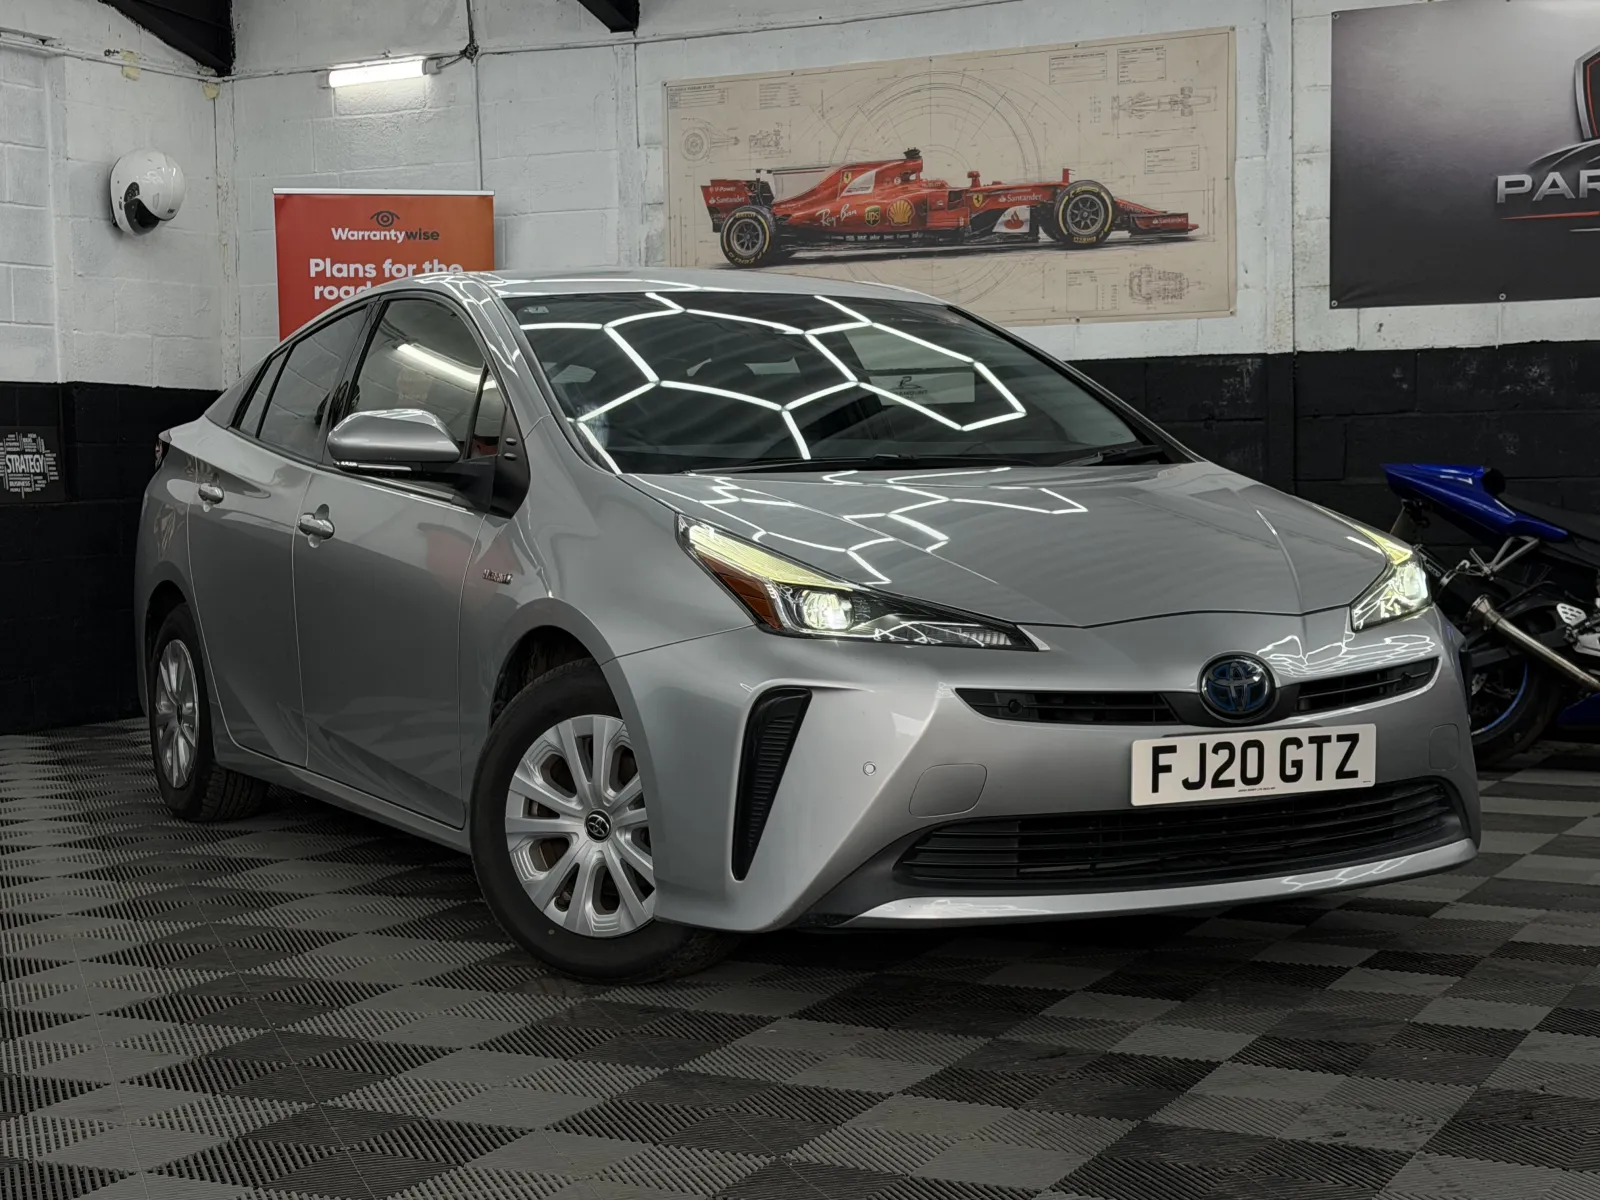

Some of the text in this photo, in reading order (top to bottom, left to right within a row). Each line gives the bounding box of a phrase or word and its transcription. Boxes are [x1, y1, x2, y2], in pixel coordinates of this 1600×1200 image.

[715, 195, 745, 204] Santander
[1006, 192, 1043, 202] Santander
[815, 204, 858, 227] Ray-Ban
[331, 227, 440, 244] Warrantywise
[309, 257, 464, 278] Plans for the
[6, 454, 44, 473] STRATEGY
[1151, 732, 1360, 794] FJ20 GTZ
